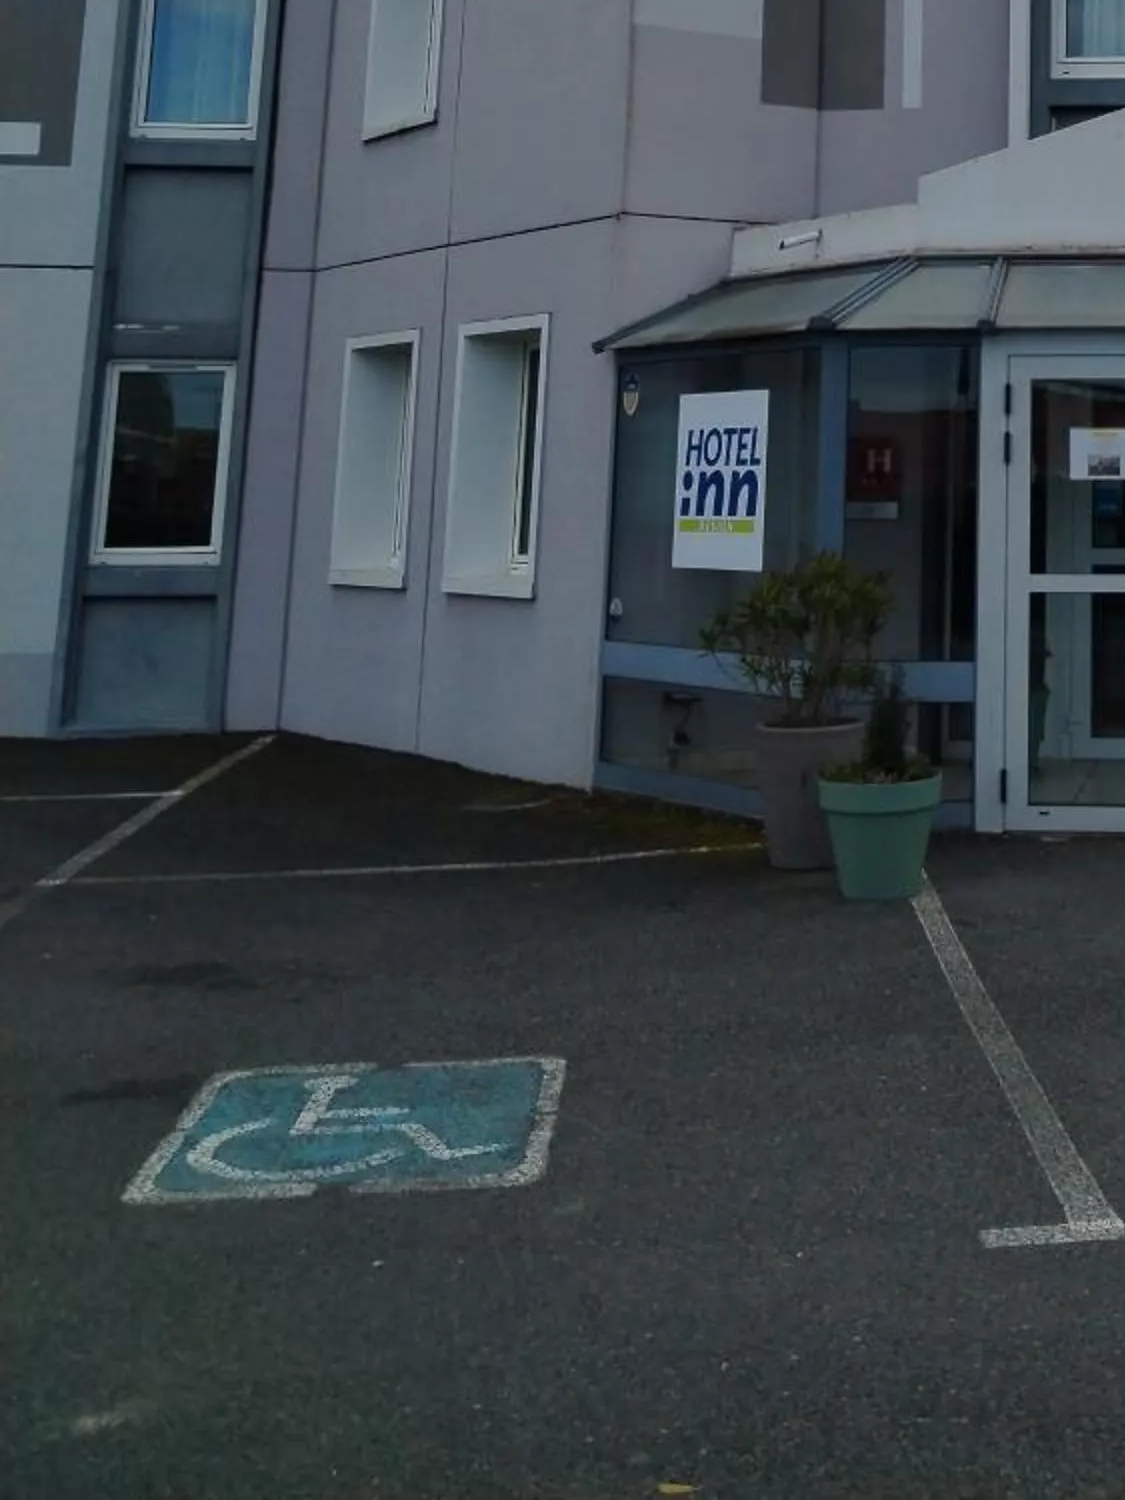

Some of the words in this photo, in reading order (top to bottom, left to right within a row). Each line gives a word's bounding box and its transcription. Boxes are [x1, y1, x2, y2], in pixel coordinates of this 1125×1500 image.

[685, 427, 761, 466] HOTEL
[867, 448, 891, 474] H
[680, 469, 759, 517] inn
